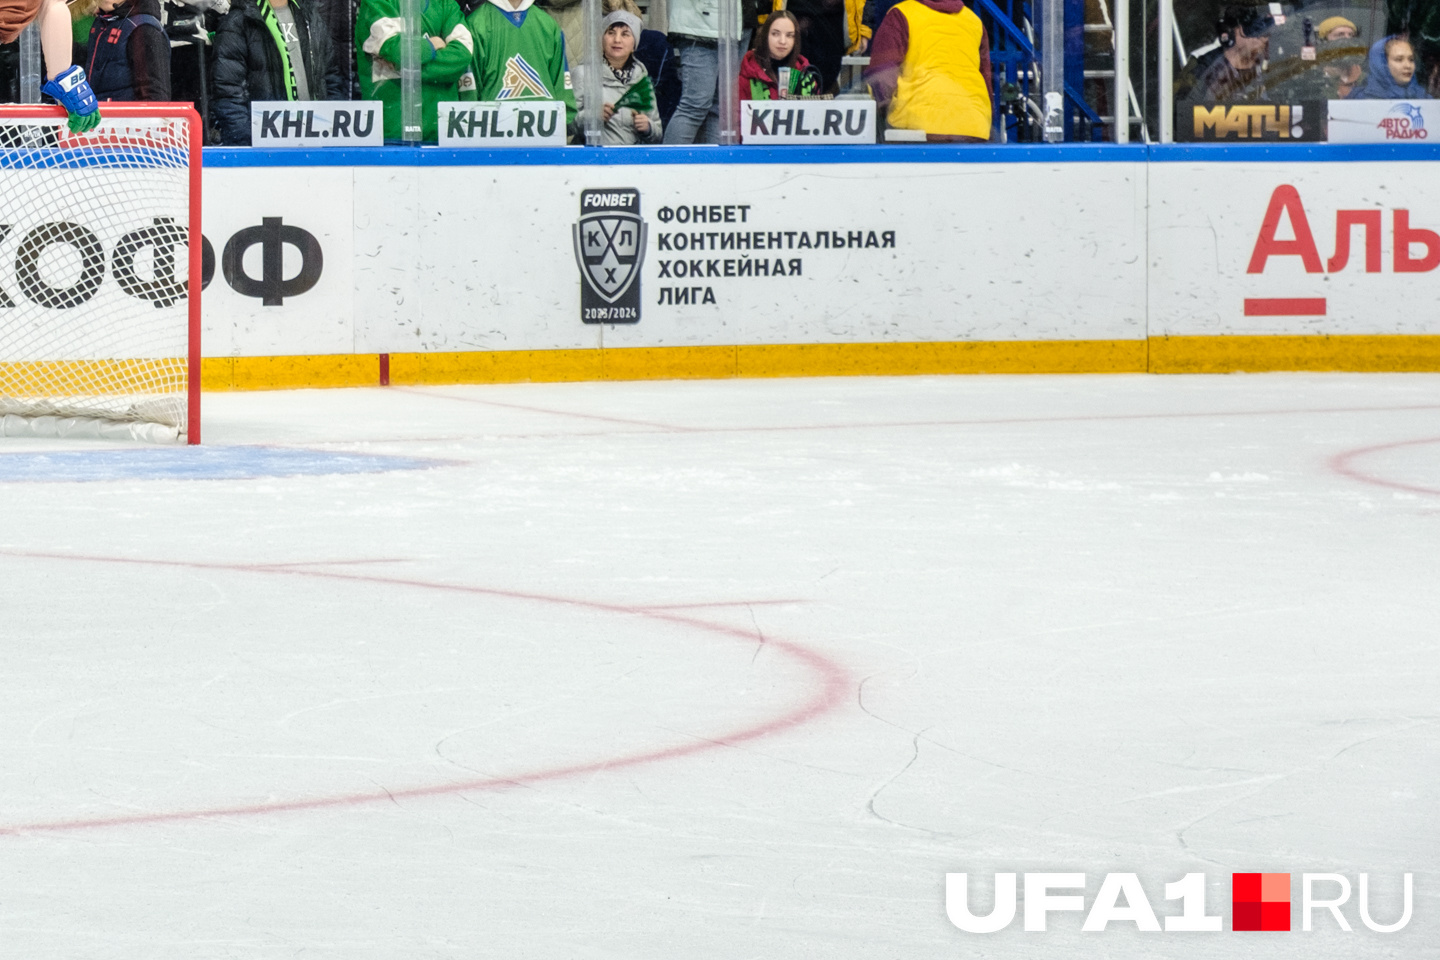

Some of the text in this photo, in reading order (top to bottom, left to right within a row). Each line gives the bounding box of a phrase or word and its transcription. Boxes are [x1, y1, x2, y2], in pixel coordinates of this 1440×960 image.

[260, 109, 375, 139] KHL.RU
[446, 109, 558, 138] KHL.RU
[749, 108, 868, 137] KHL.RU
[1193, 104, 1304, 139] МАТЧ!
[1376, 117, 1410, 131] АВТО
[1385, 127, 1428, 140] РАДИО
[583, 193, 637, 207] FONBET
[656, 204, 751, 224] ФОНБЕТ
[656, 230, 897, 252] КОНТИНЕНТАЛЬНАЯ
[656, 254, 803, 279] ХОККЕЙНАЯ
[656, 286, 717, 306] ЛИГА
